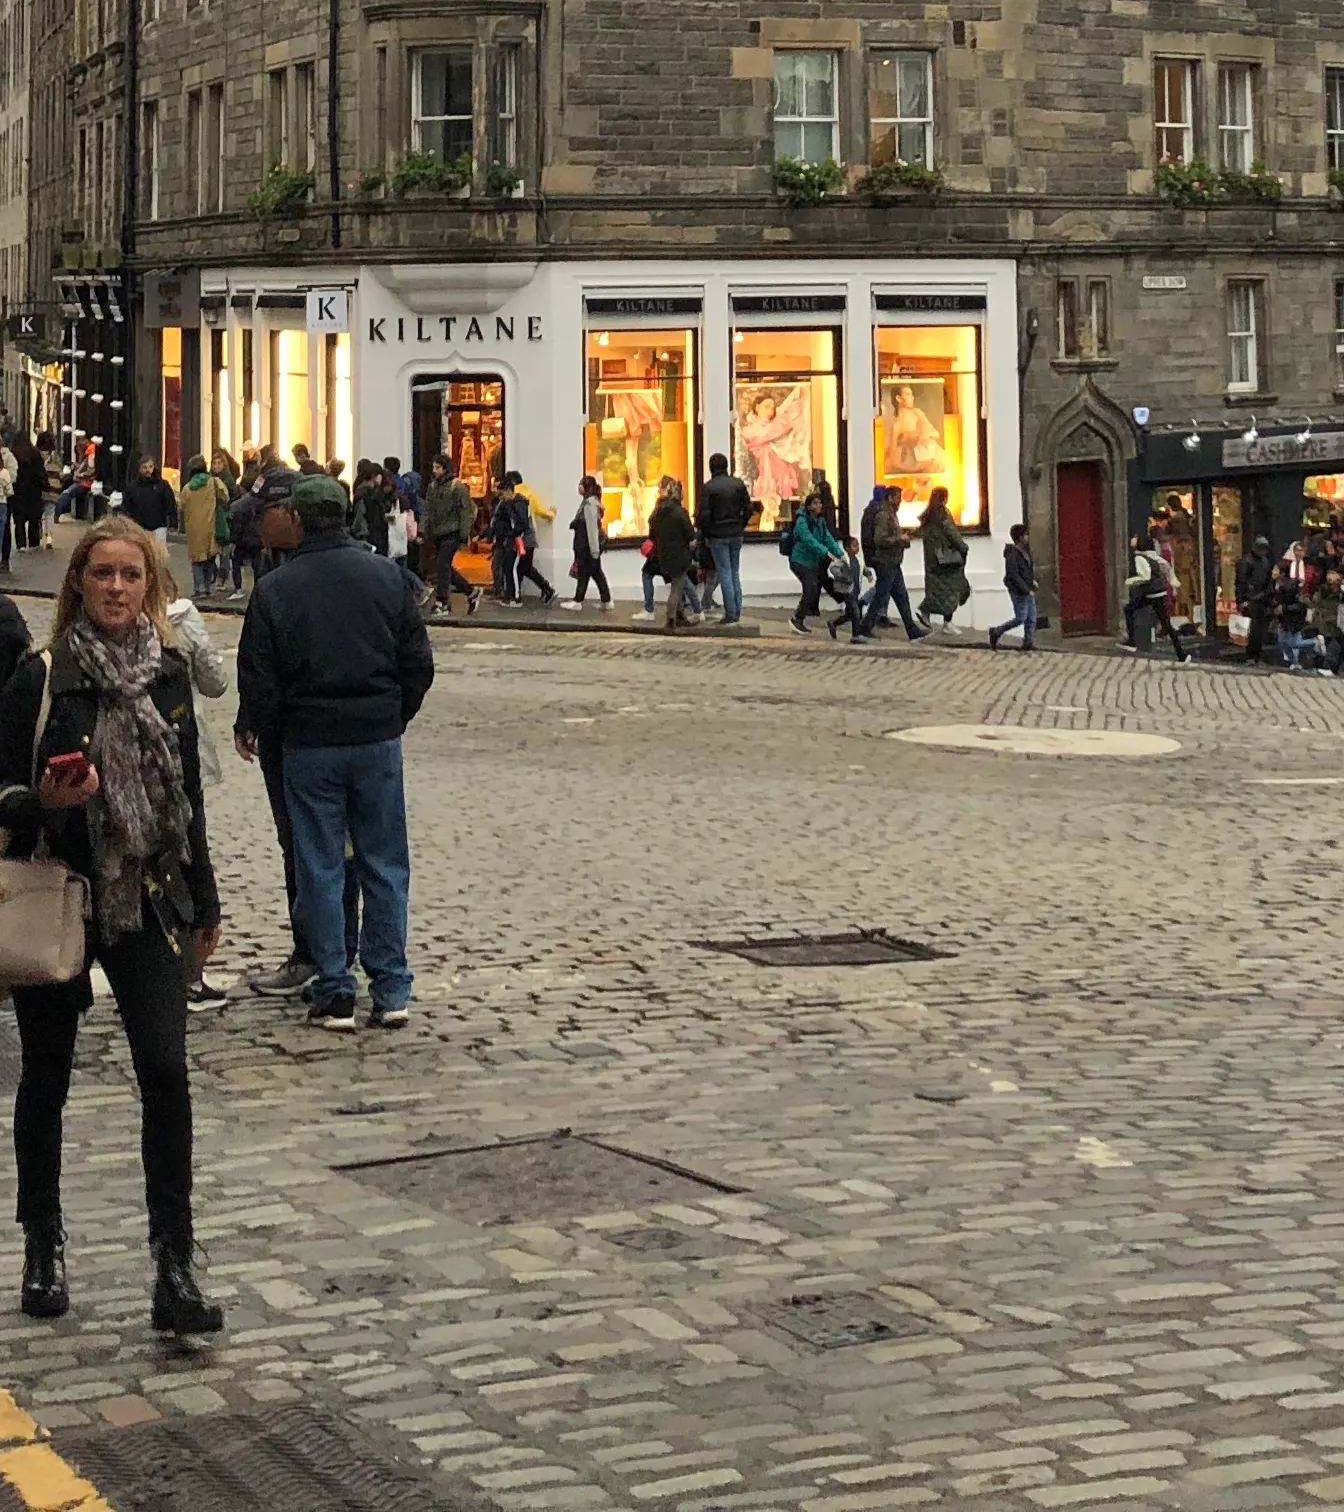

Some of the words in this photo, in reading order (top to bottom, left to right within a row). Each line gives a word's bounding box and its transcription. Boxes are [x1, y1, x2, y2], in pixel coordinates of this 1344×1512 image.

[317, 296, 336, 320] K
[616, 298, 675, 312] KILTANE
[762, 297, 819, 310] KILTANE
[904, 295, 960, 309] KILTANE
[21, 316, 34, 333] K
[368, 316, 544, 343] KILTANE
[1246, 439, 1328, 464] CASHMERE
